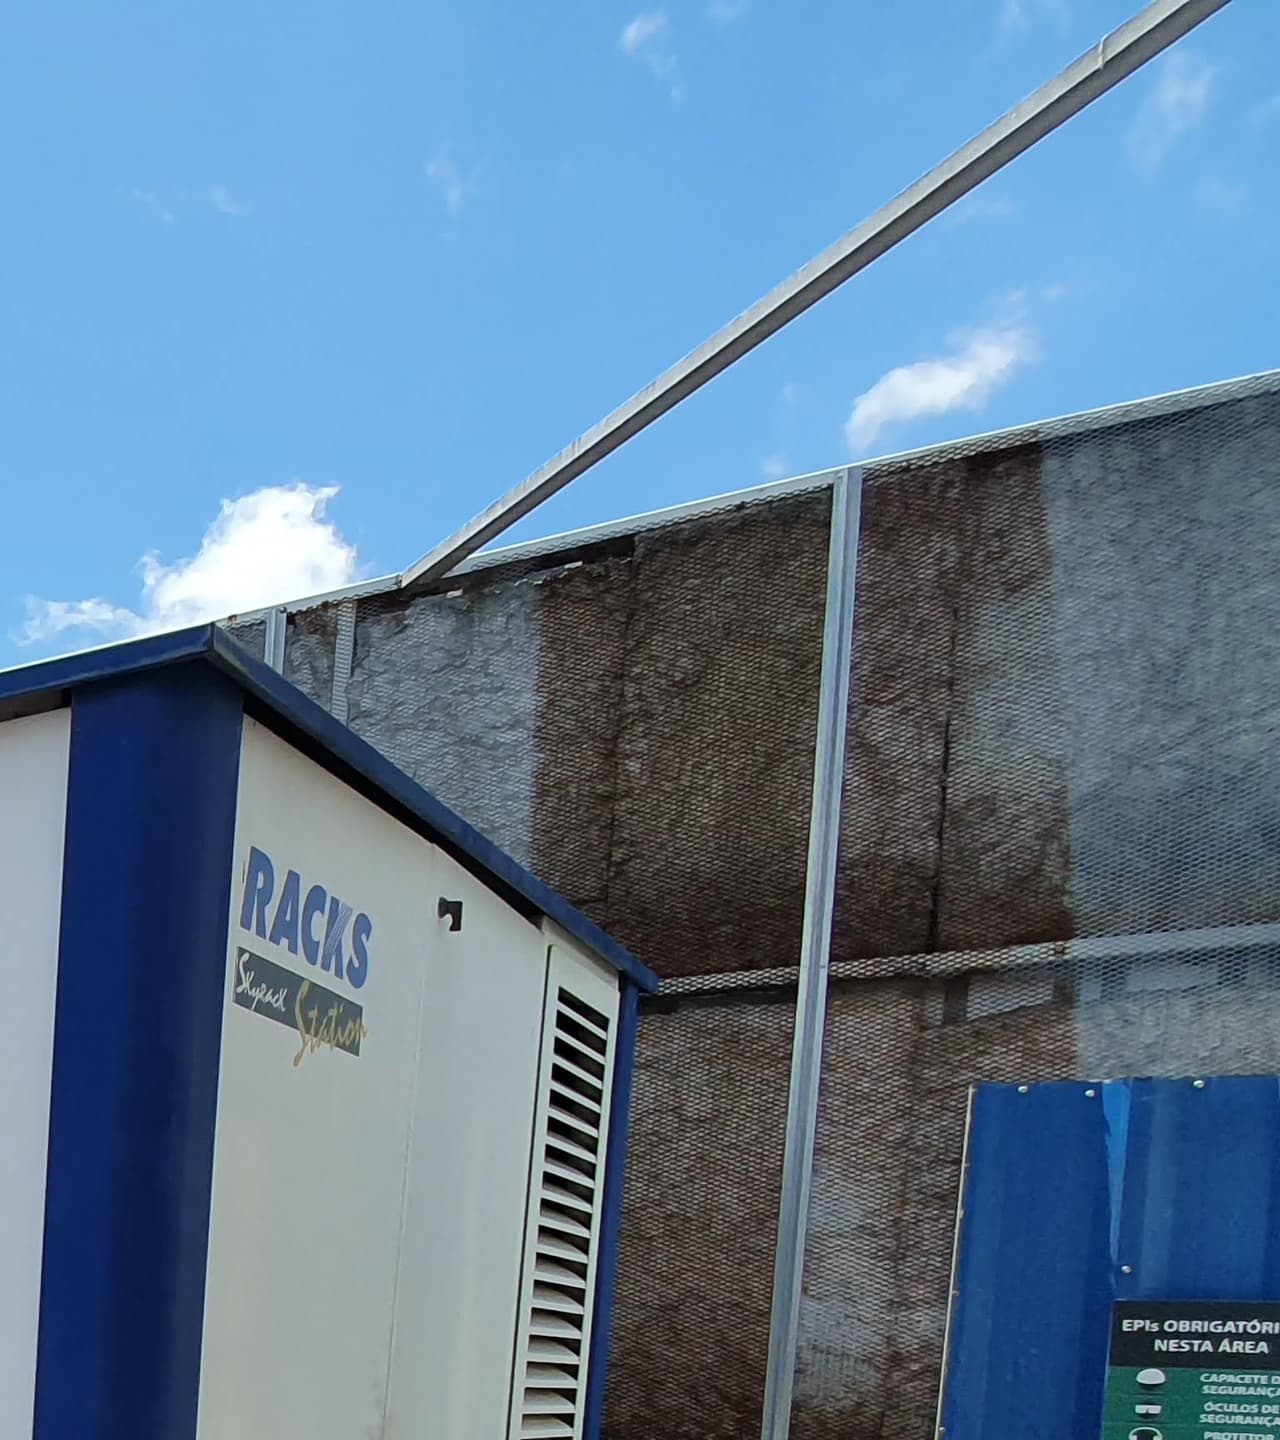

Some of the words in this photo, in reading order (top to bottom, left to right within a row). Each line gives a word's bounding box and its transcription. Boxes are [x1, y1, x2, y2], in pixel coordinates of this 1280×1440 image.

[241, 846, 372, 989] RACKS
[293, 979, 367, 1067] Station
[1122, 1320, 1159, 1332] EPIs
[1164, 1319, 1280, 1334] OBRIGATÓRI
[1154, 1339, 1213, 1352] NESTA
[1218, 1338, 1269, 1354] ÁREA
[1200, 1373, 1268, 1385] CAPACETE
[1271, 1375, 1280, 1385] D
[1204, 1402, 1258, 1413] ÓCULOS
[1261, 1404, 1280, 1414] DE
[1200, 1414, 1280, 1428] SEGURANÇA
